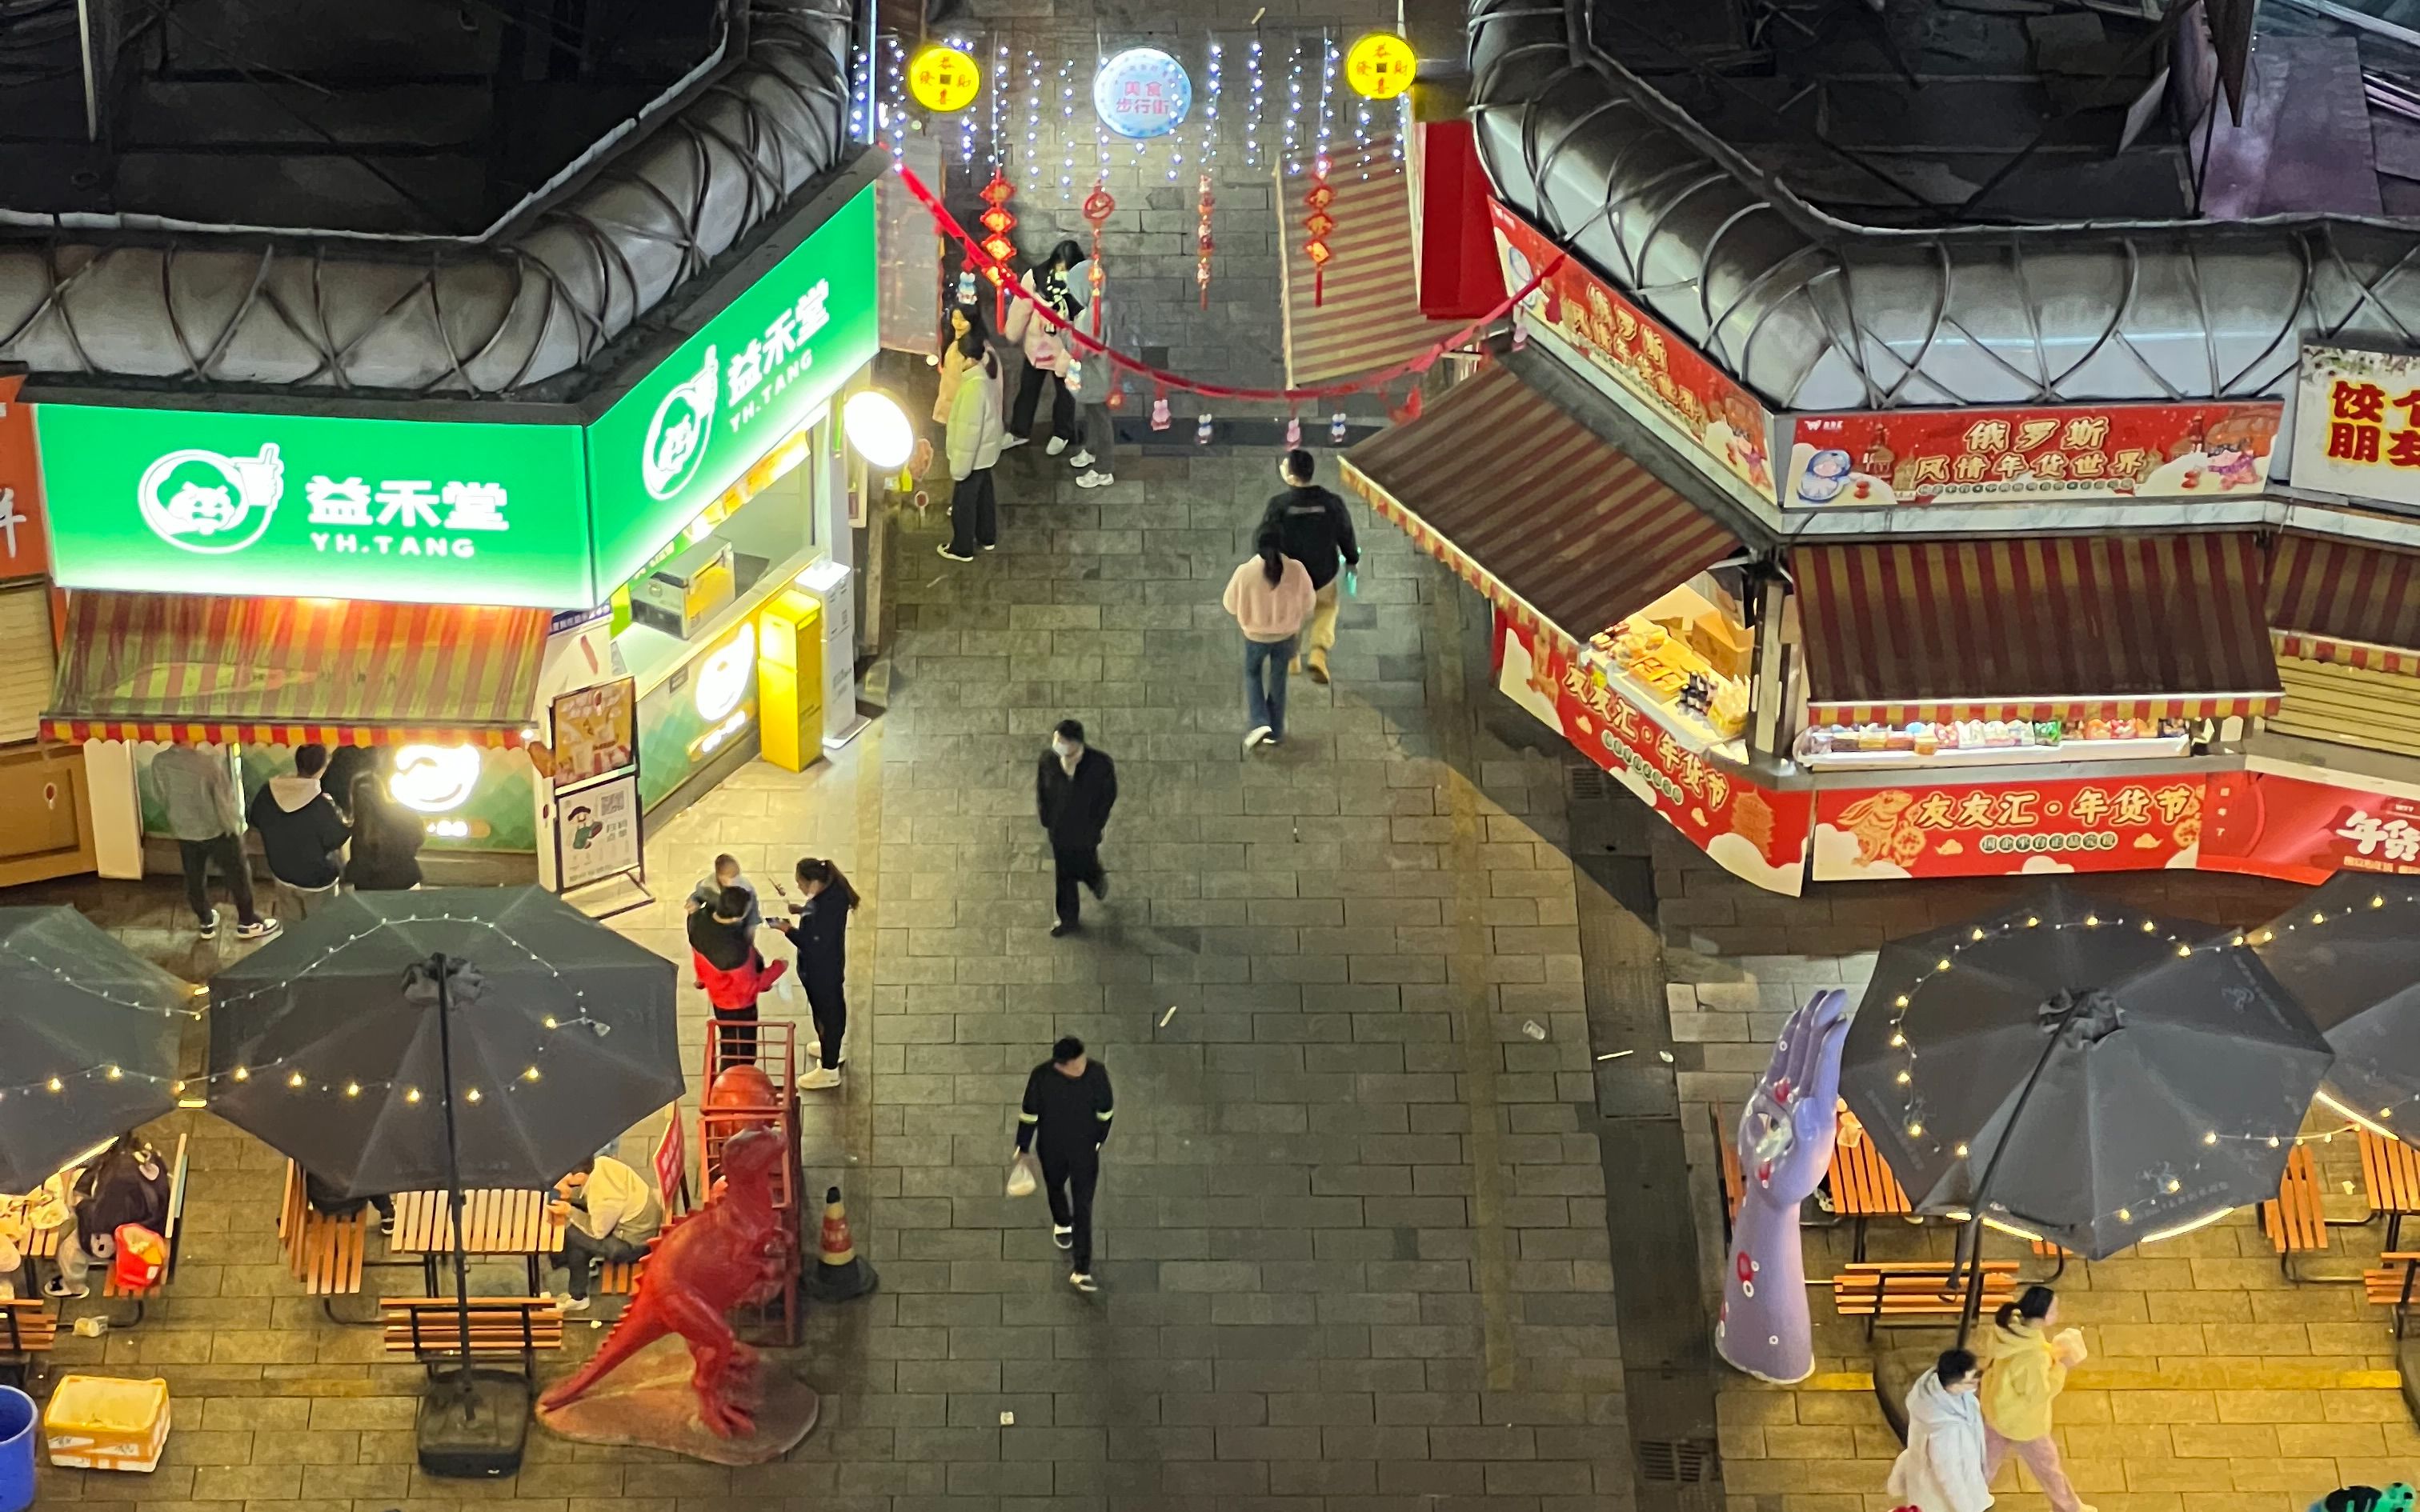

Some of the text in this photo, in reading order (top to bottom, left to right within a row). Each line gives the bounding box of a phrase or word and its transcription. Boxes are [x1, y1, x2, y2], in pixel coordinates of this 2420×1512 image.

[727, 278, 830, 407] 益禾堂
[729, 348, 812, 433] YH.TANG
[1965, 418, 2108, 452] 俄罗斯
[1916, 451, 2145, 482] 风情年货世界
[305, 474, 510, 531] 益禾堂
[310, 531, 475, 558] YH.TANG
